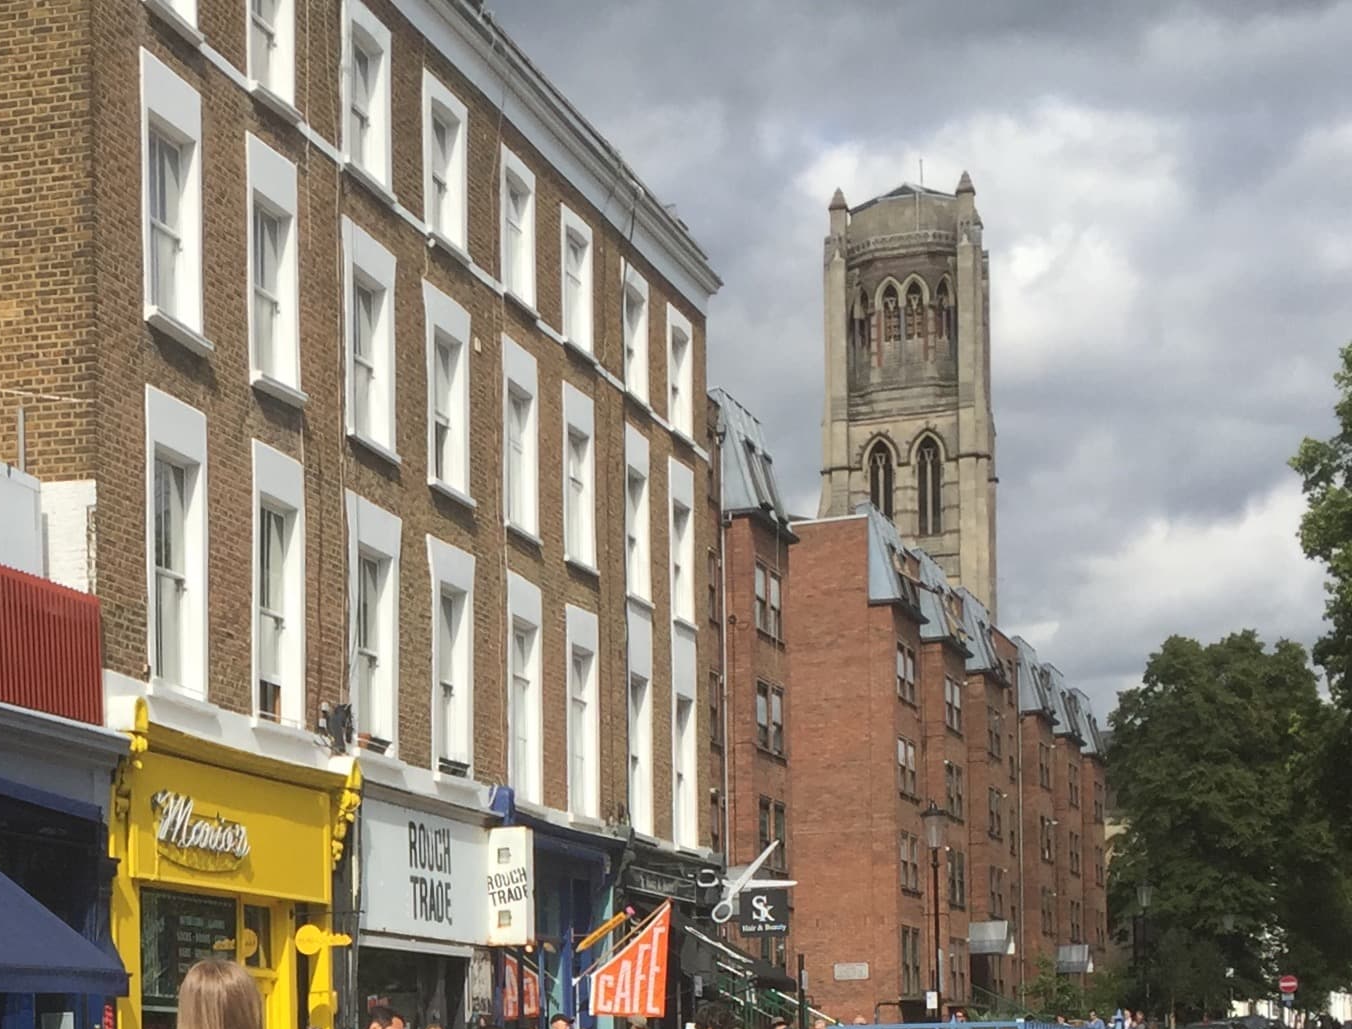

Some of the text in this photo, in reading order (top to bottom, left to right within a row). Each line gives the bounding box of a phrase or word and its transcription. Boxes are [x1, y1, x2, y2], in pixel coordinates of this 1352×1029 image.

[408, 821, 451, 874] ROUGH
[410, 875, 452, 925] TRADE
[487, 867, 528, 891] ROUGH
[488, 884, 528, 906] TRADE
[597, 918, 665, 1014] CAFÉ
